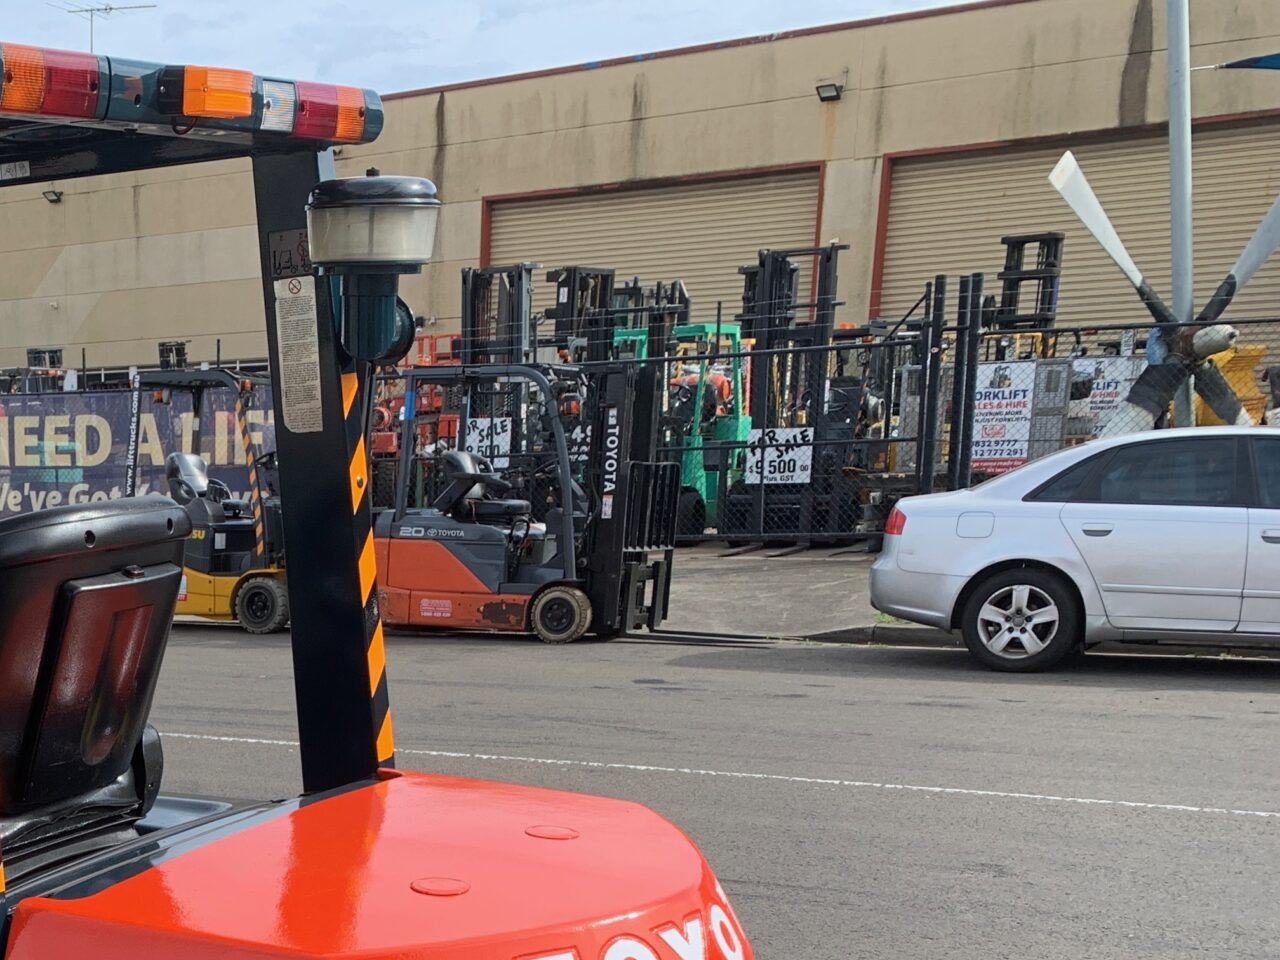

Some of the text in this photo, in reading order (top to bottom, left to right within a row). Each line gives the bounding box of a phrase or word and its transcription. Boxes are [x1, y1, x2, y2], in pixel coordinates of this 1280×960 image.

[975, 389, 1029, 401] ORKLIFT
[976, 401, 994, 410] LES
[138, 412, 165, 466] A
[179, 410, 276, 466] LIF
[972, 440, 992, 448] 832
[603, 425, 620, 493] TOYOTA
[768, 458, 797, 475] 500
[400, 526, 465, 537] 20 TOYOTA
